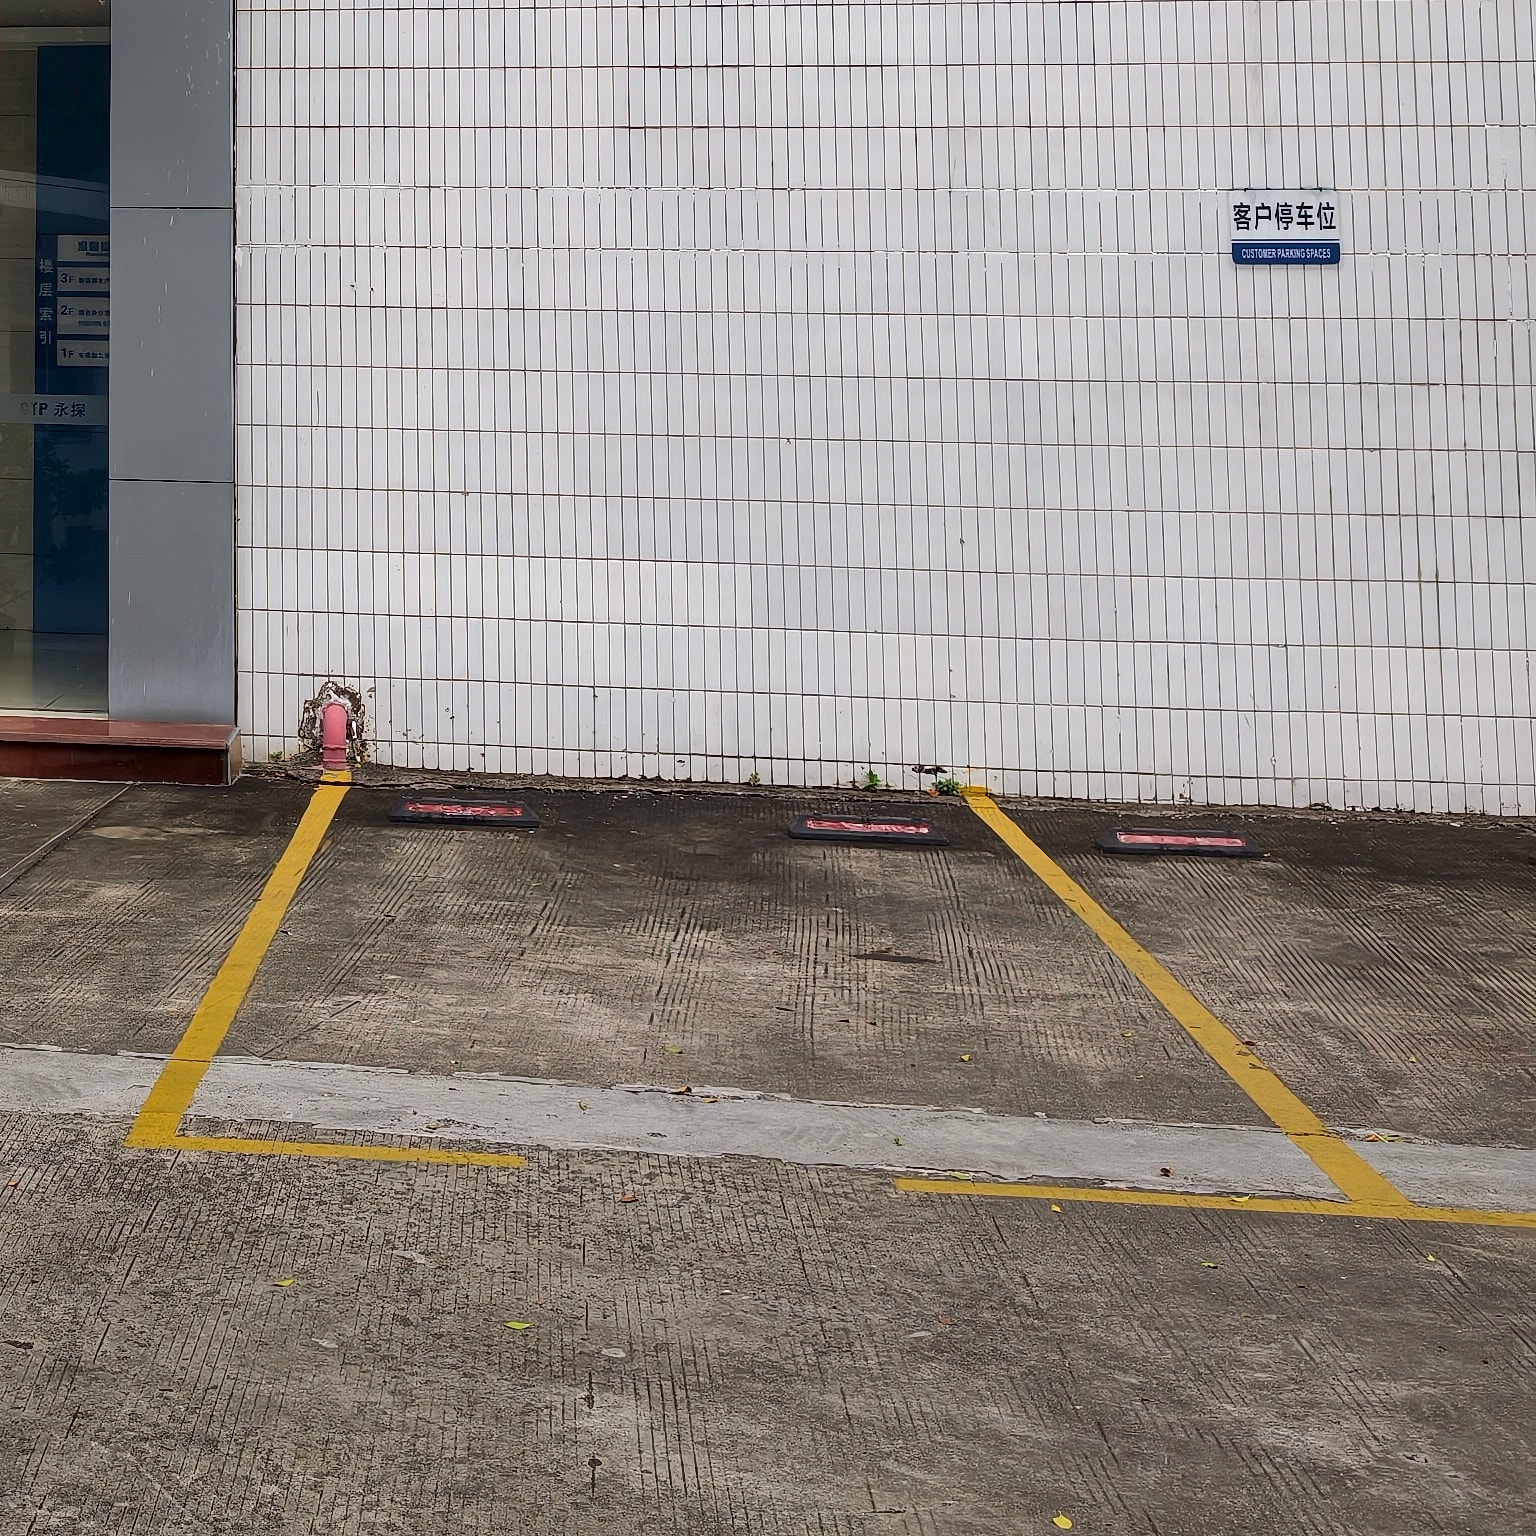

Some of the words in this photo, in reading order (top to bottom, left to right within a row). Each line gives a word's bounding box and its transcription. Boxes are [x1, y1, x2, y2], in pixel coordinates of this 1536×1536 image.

[1232, 202, 1336, 231] 客户停车位
[1241, 248, 1277, 259] CUSTOMER
[1277, 248, 1306, 259] PARKING
[1306, 248, 1331, 259] SPACES
[60, 273, 75, 284] 3F
[38, 258, 54, 345] 楼层索引
[60, 305, 75, 316] 2F
[53, 402, 86, 417] 永探
